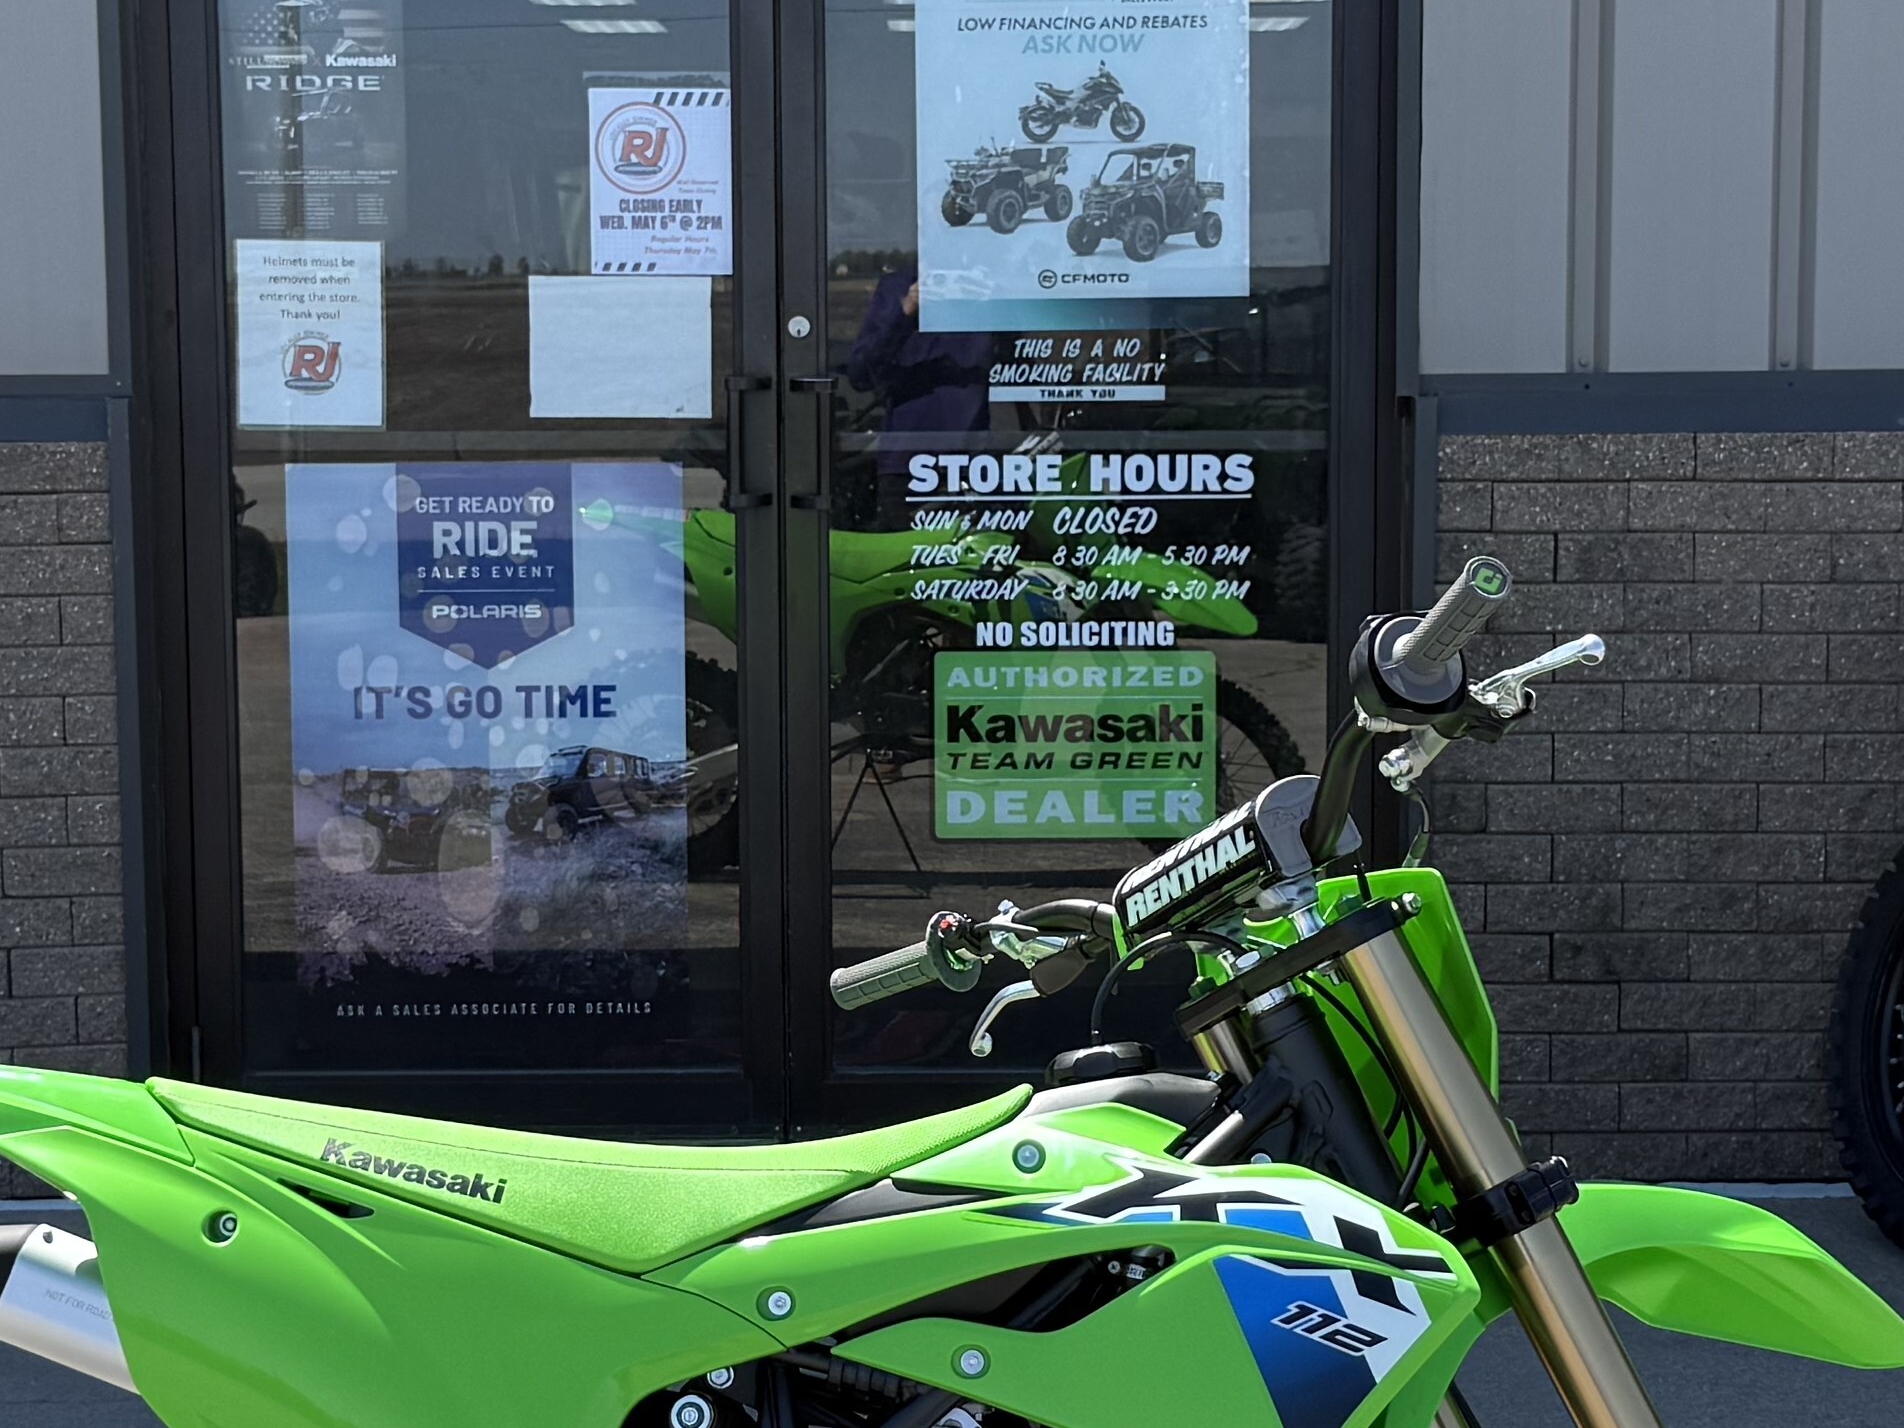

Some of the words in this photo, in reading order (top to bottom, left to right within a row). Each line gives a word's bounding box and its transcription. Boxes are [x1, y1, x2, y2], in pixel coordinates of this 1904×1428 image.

[957, 17, 997, 31] LOW
[998, 16, 1096, 31] FINANCING
[1099, 16, 1137, 29] AND
[1141, 15, 1209, 29] REBATES
[1022, 34, 1074, 54] ASK
[1077, 33, 1145, 54] NOW
[325, 53, 397, 67] Kawasaki
[246, 75, 381, 91] RIDGE
[619, 127, 669, 167] RJ
[619, 199, 666, 213] CLOSING
[669, 199, 703, 213] EARLY
[599, 215, 628, 230] WED.
[631, 215, 657, 230] MAY
[696, 216, 723, 230] 2PM
[263, 256, 308, 267] Helmets
[311, 257, 339, 267] must
[341, 256, 355, 267] be
[268, 274, 317, 285] removed
[320, 274, 350, 285] when
[1061, 273, 1130, 284] CFMOTO
[259, 293, 306, 304] entering
[308, 293, 326, 302] the
[280, 309, 313, 319] Thank
[316, 310, 340, 321] you!
[1014, 338, 1053, 358] THIS
[1062, 338, 1081, 358] IS
[1091, 338, 1102, 357] A
[1113, 338, 1141, 358] NO
[289, 342, 341, 382] RJ
[988, 363, 1073, 384] SMOKING
[1082, 363, 1166, 383] FACILITY
[1039, 389, 1084, 398] THANK
[1090, 389, 1116, 398] YOU
[907, 454, 1062, 493] STORE
[1089, 453, 1255, 493] HOURS
[415, 497, 453, 513] GET
[458, 496, 524, 513] READY
[528, 496, 555, 513] TO
[910, 510, 959, 531] SUN
[976, 510, 1034, 531] MON
[1053, 506, 1158, 535] CLOSED
[433, 520, 538, 559] RIDE
[910, 545, 962, 566] TUES
[982, 544, 1020, 565] FRI
[1101, 544, 1144, 565] AM
[1211, 544, 1251, 566] PM
[417, 566, 481, 578] SALES
[492, 565, 555, 578] EVENT
[910, 579, 1030, 600] SATURDAY
[1100, 579, 1143, 600] AM
[1211, 579, 1251, 600] PM
[432, 604, 542, 619] POLARIS
[976, 621, 1014, 647] NO
[1020, 620, 1175, 647] SOLICITING
[947, 666, 1204, 688] AUTHORIZED
[353, 685, 433, 720] IT'S
[446, 684, 503, 720] GO
[515, 684, 617, 719] TIME
[946, 703, 1204, 744] Kawasaki
[946, 752, 1055, 770] TEAM
[1069, 751, 1204, 770] GREEN
[946, 789, 1205, 824] DEALER
[1125, 825, 1256, 927] RENTHAL
[337, 1004, 366, 1016] ASK
[375, 1005, 383, 1016] A
[392, 1004, 441, 1016] SALES
[451, 1003, 538, 1015] ASSOCIATE
[548, 1003, 576, 1014] FOR
[585, 1002, 652, 1014] DETAILS
[320, 1137, 508, 1204] Kawasaki
[1270, 1300, 1389, 1357] 112
